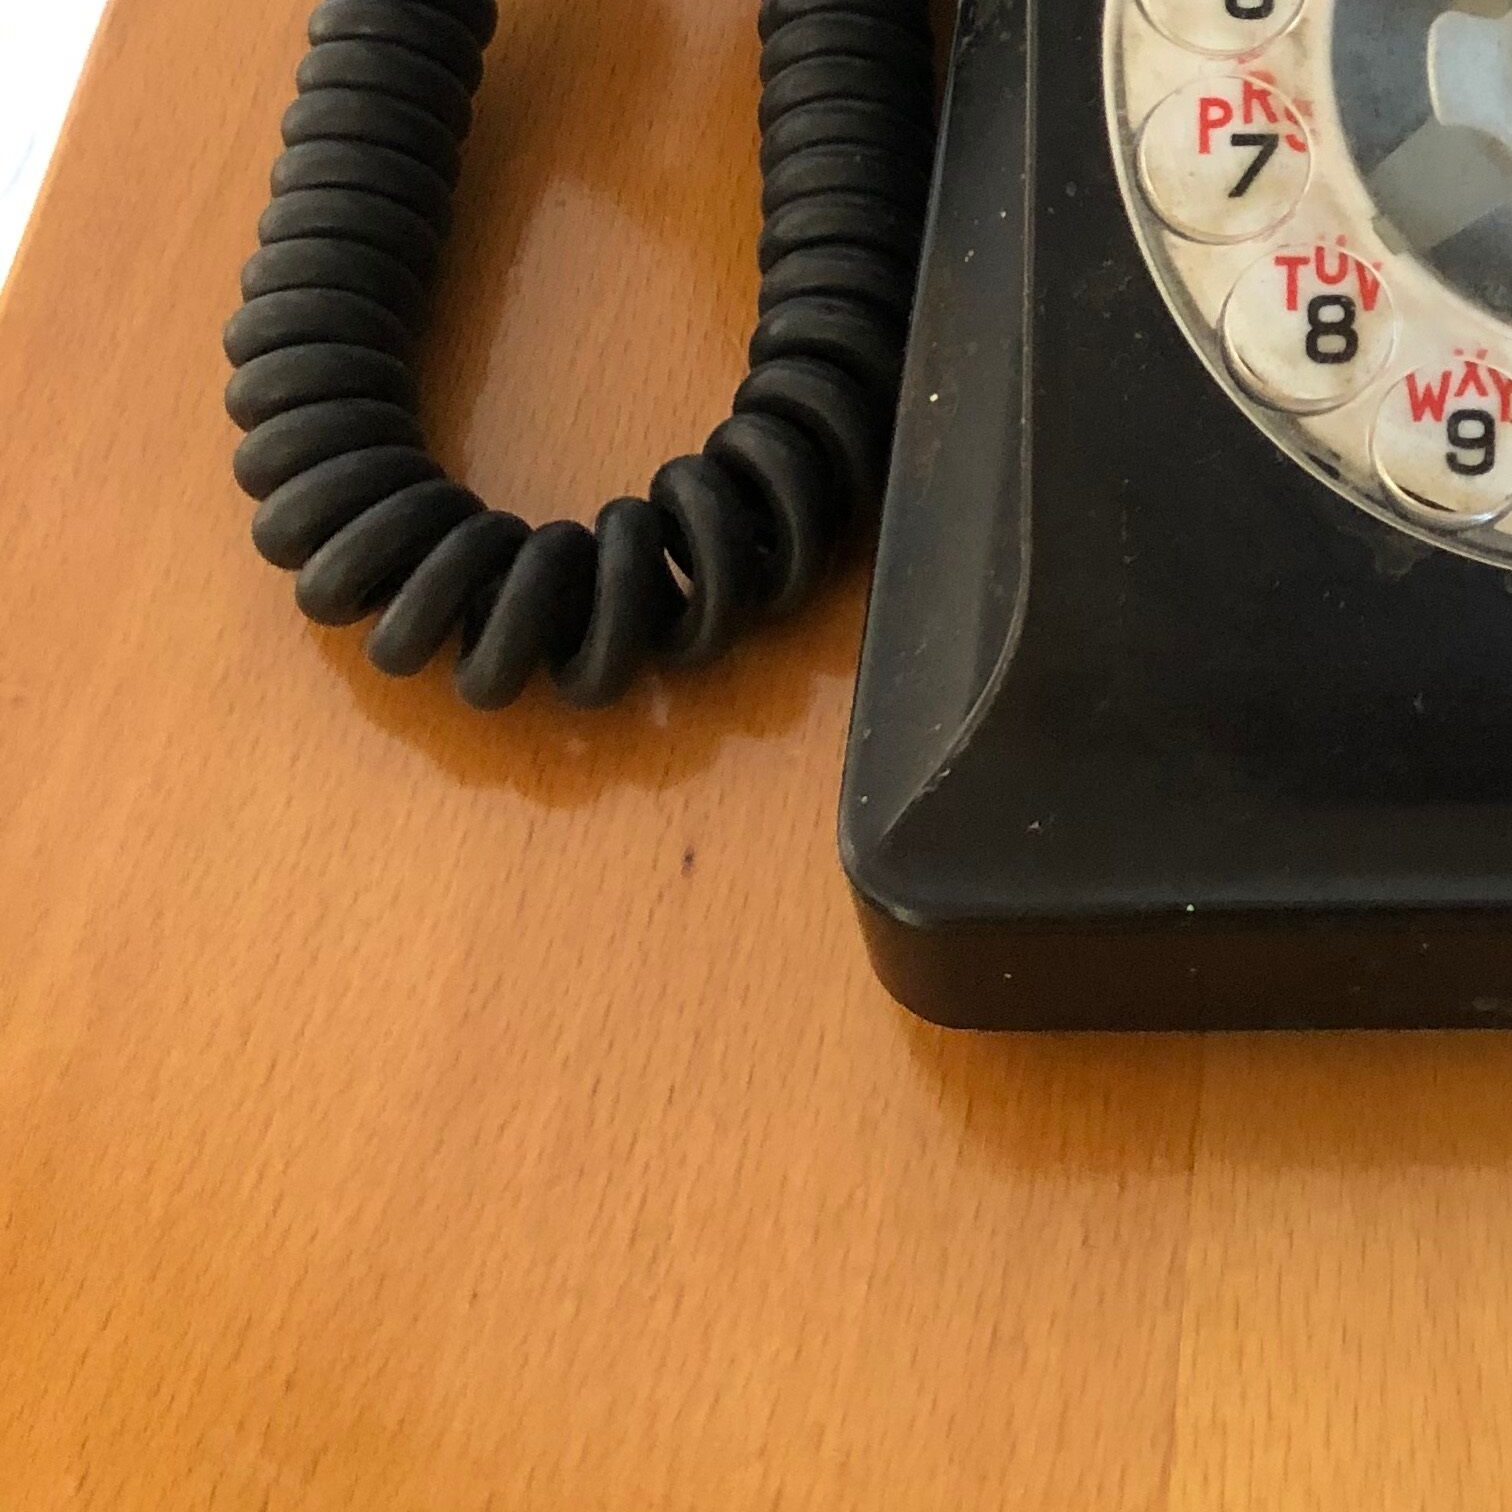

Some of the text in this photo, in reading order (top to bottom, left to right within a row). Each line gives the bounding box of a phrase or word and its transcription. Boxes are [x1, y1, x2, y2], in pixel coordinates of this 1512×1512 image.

[1229, 133, 1280, 198] 7
[1274, 244, 1381, 312] TUV
[1305, 294, 1358, 364] 8
[1446, 408, 1496, 475] 9
